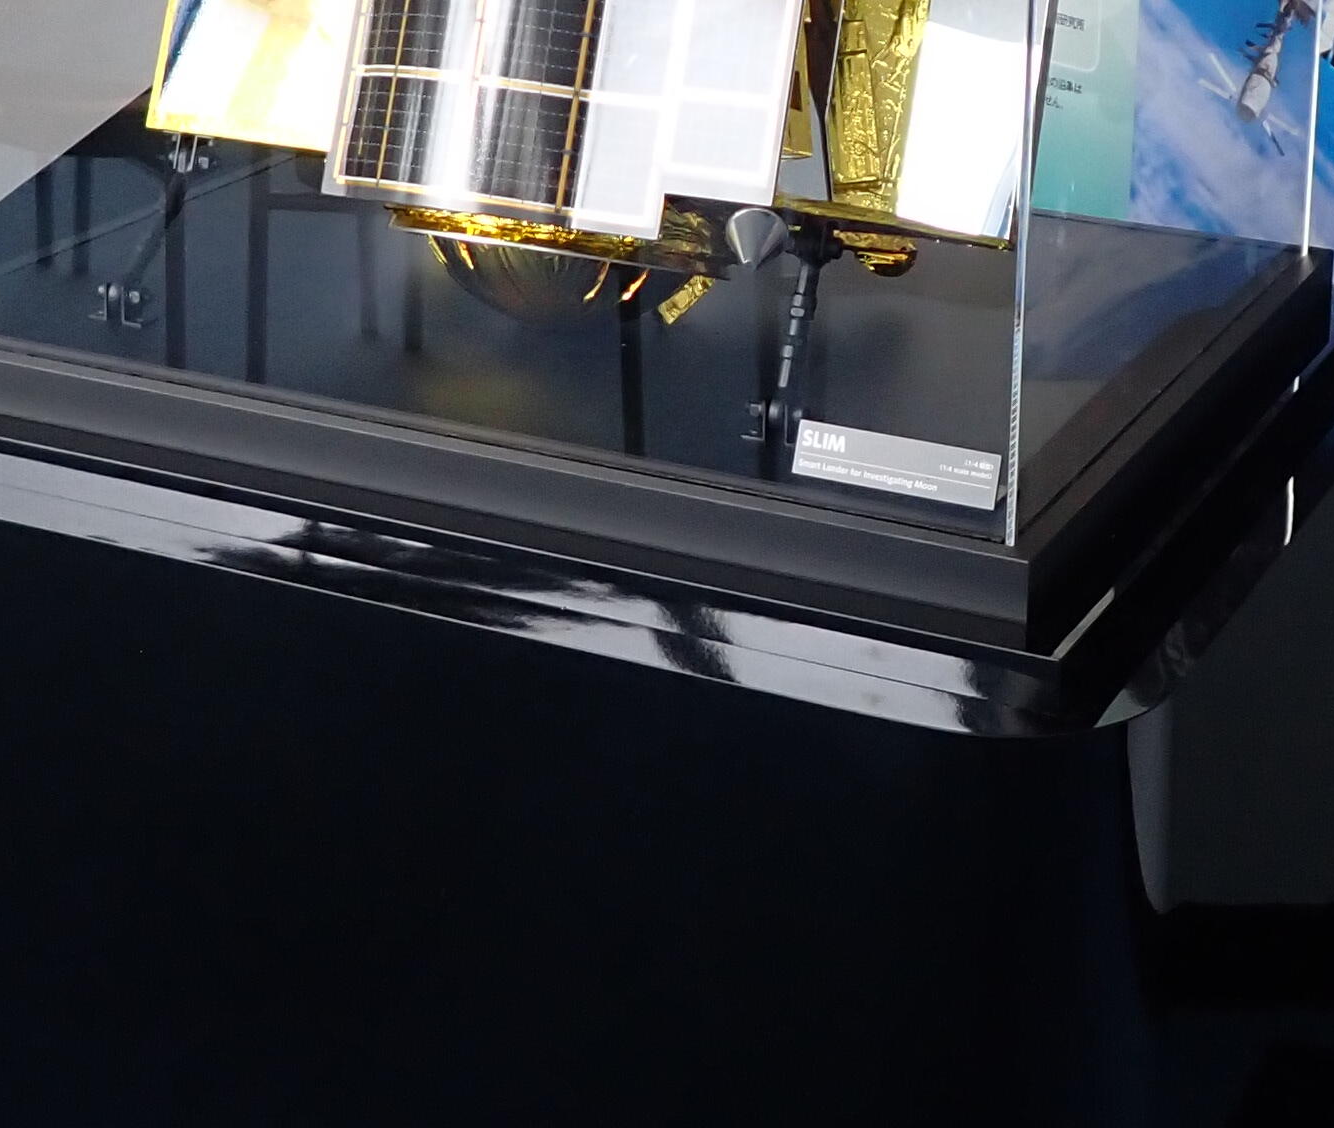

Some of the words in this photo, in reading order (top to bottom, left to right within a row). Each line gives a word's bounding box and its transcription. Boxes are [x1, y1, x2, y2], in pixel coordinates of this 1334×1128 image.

[801, 429, 847, 454] SLIM
[798, 458, 822, 472] Smart
[822, 462, 849, 477] Lander
[850, 466, 863, 478] for
[863, 470, 914, 490] Investigating
[914, 479, 939, 492] Moon
